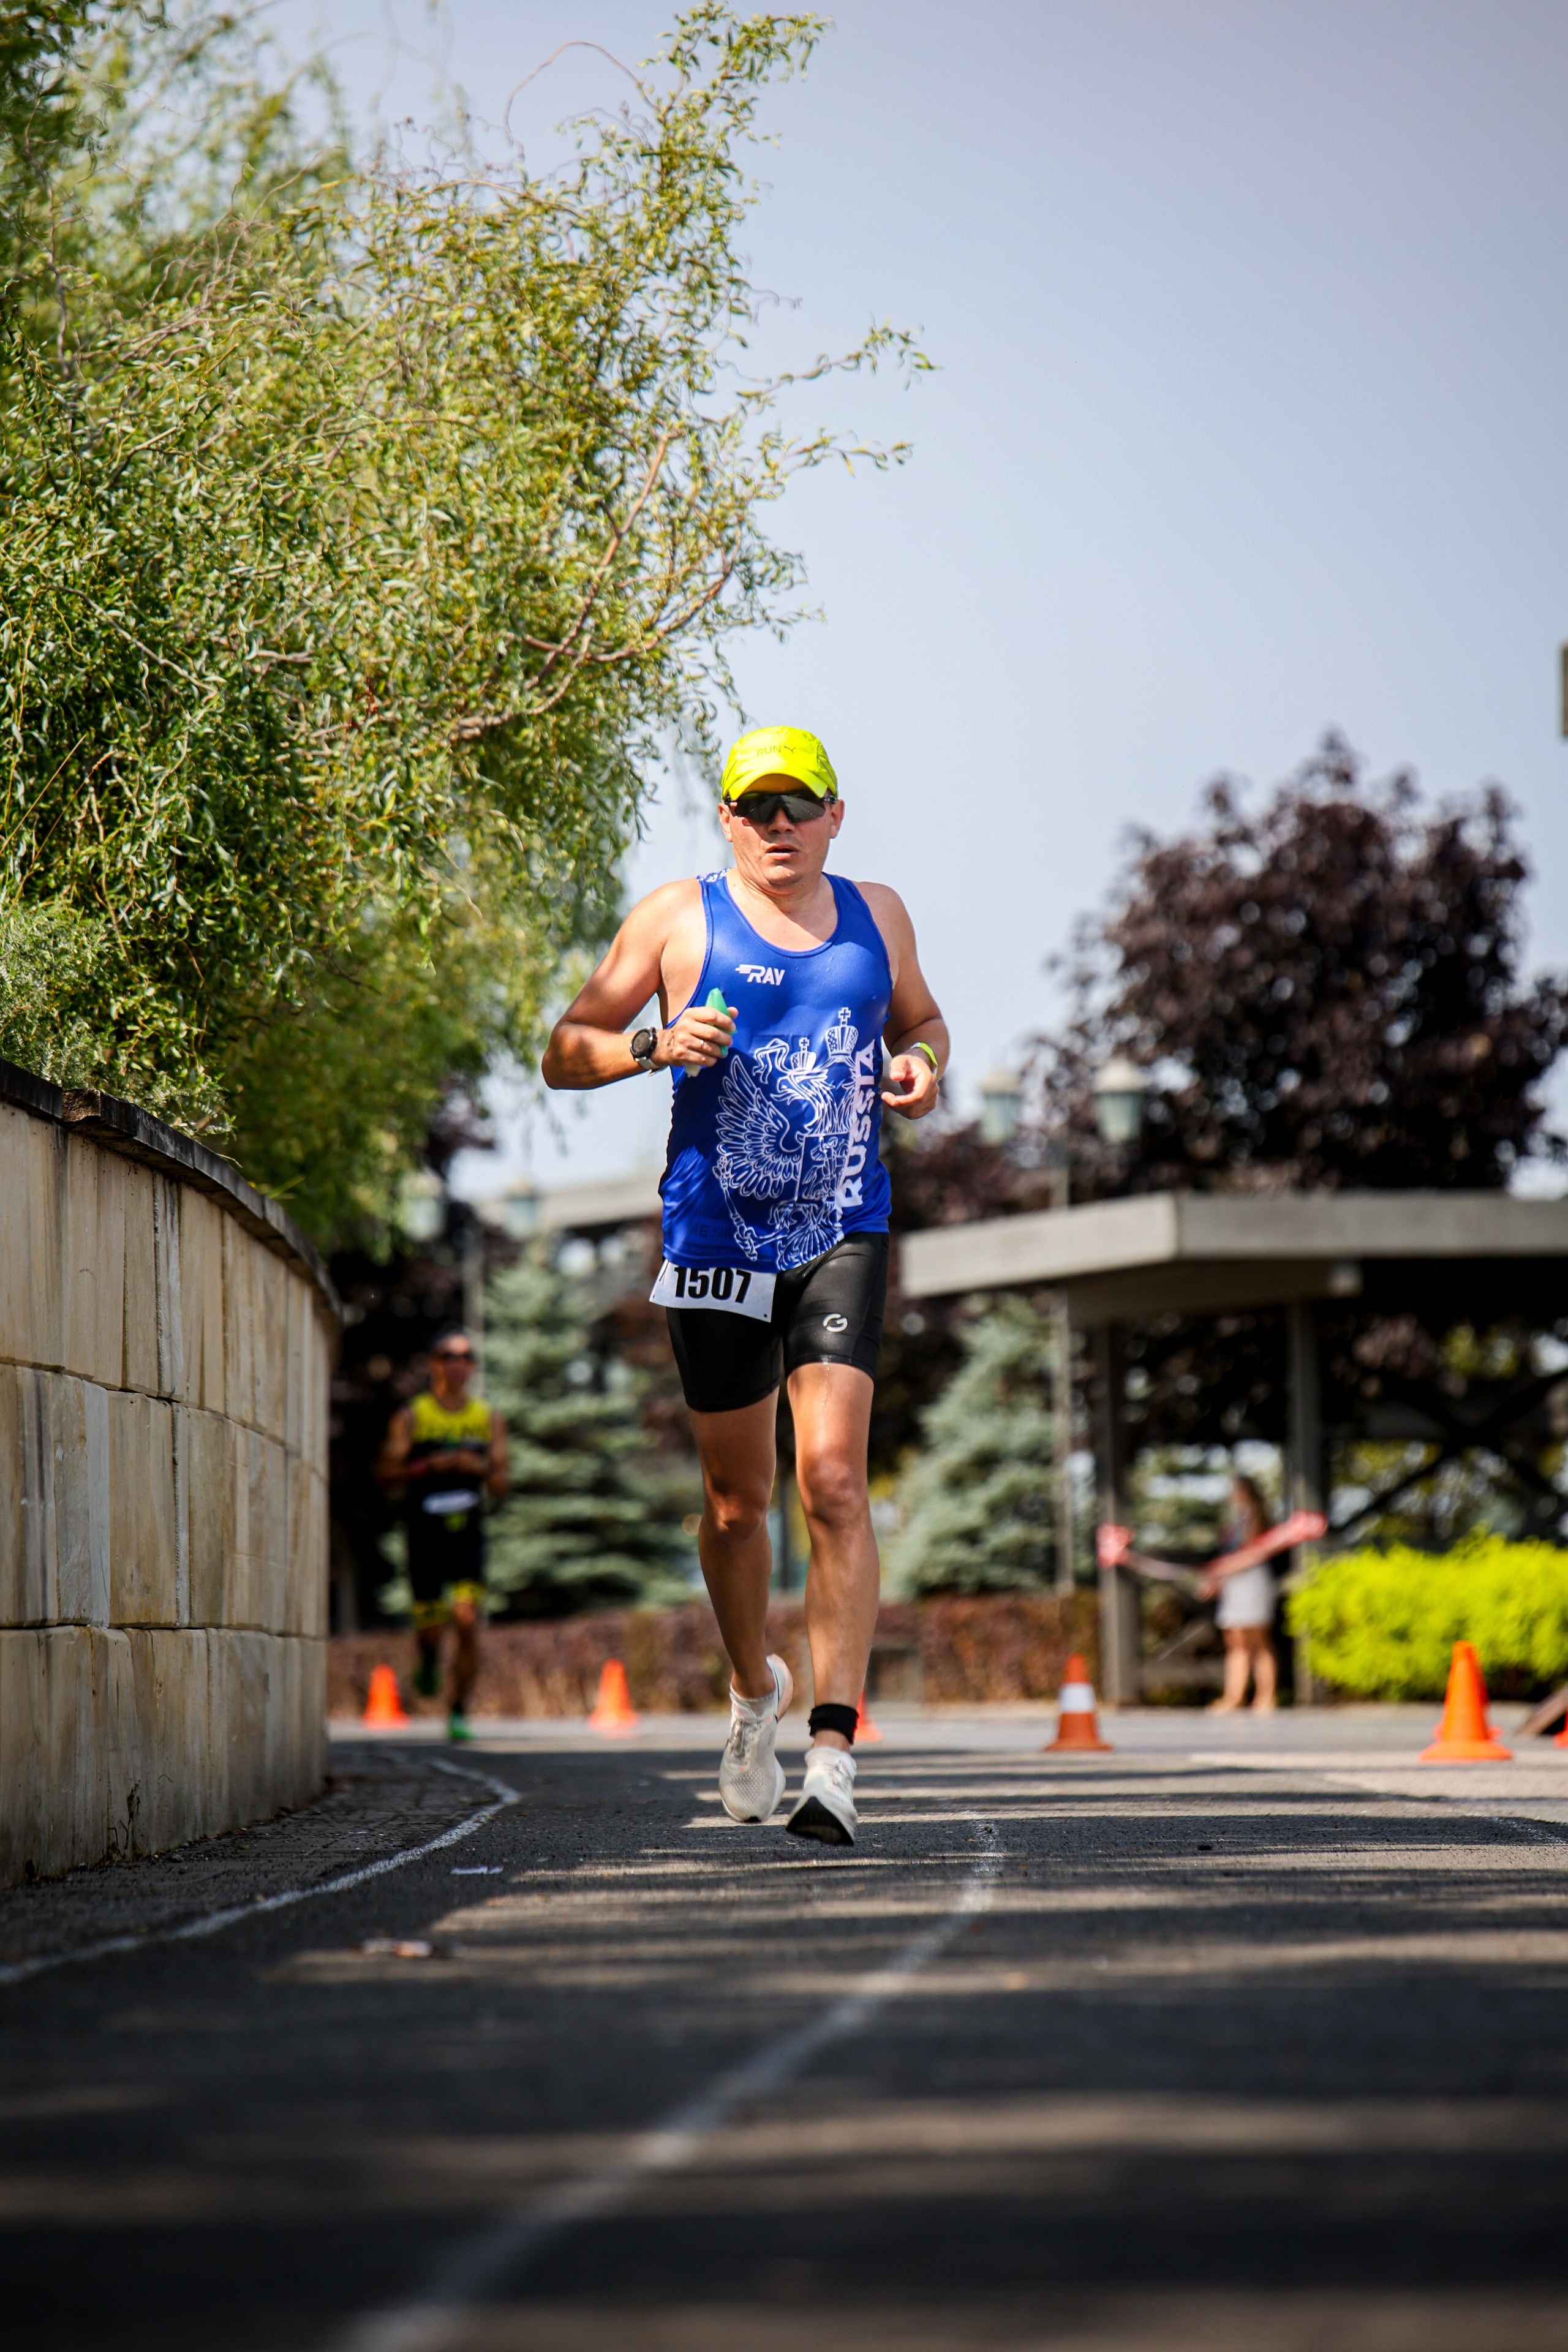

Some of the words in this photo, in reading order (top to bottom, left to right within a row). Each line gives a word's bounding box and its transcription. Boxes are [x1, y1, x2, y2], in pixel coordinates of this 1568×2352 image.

[756, 745, 781, 757] RUN
[736, 963, 785, 986] RAY
[837, 1039, 875, 1207] RUSSIA
[674, 1266, 752, 1304] 1507
